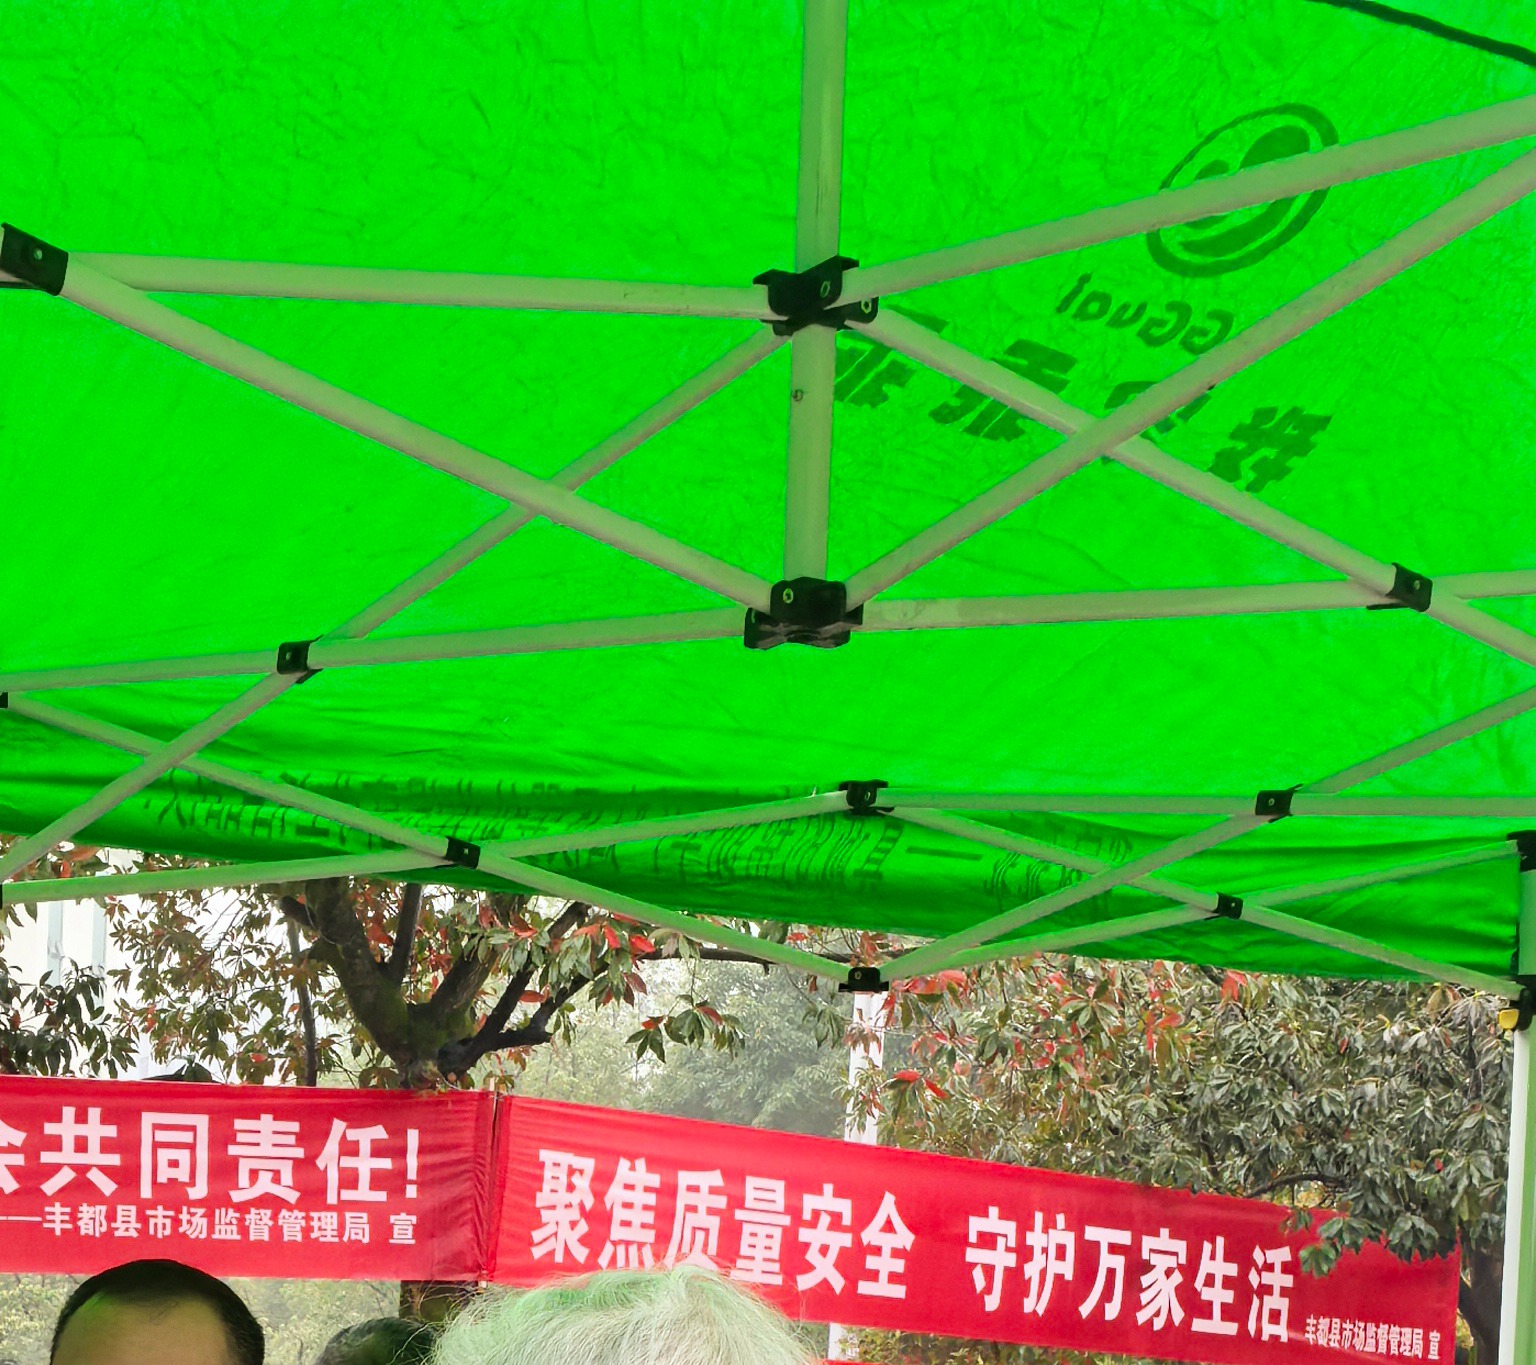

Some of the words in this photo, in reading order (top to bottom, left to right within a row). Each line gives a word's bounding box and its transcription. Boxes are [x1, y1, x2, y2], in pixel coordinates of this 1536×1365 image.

[389, 1213, 416, 1245] 宣
[531, 1149, 915, 1300] 聚焦质量安全
[965, 1206, 1295, 1343] 守护万家生活
[1305, 1314, 1424, 1359] 丰都县市场监督管理局
[1428, 1330, 1441, 1360] 宣
